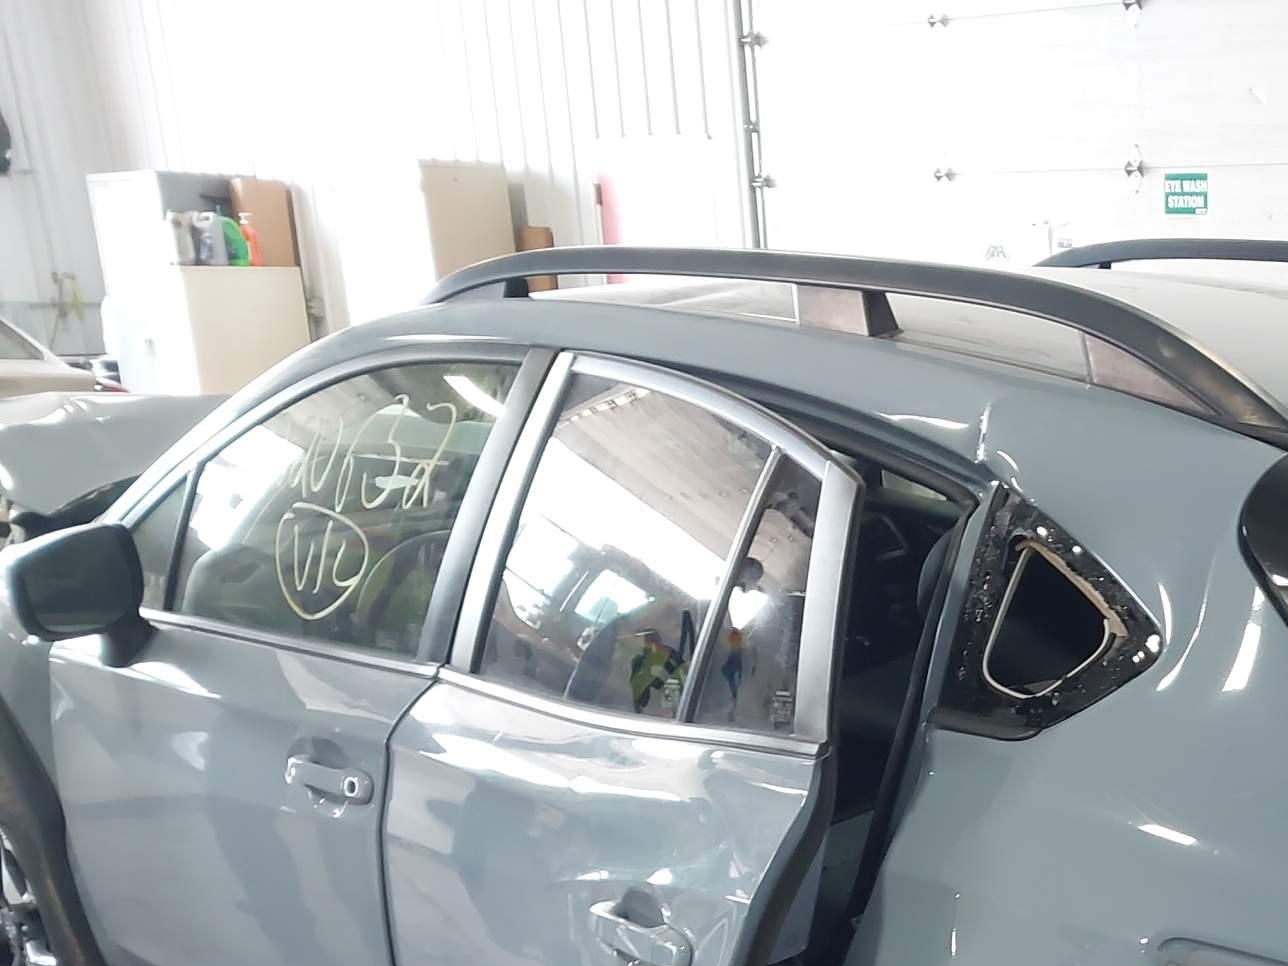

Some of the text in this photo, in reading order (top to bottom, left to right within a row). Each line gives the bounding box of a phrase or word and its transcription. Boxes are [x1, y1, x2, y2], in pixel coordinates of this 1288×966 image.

[1164, 179, 1208, 193] EYE WASH
[1167, 195, 1205, 208] STATION
